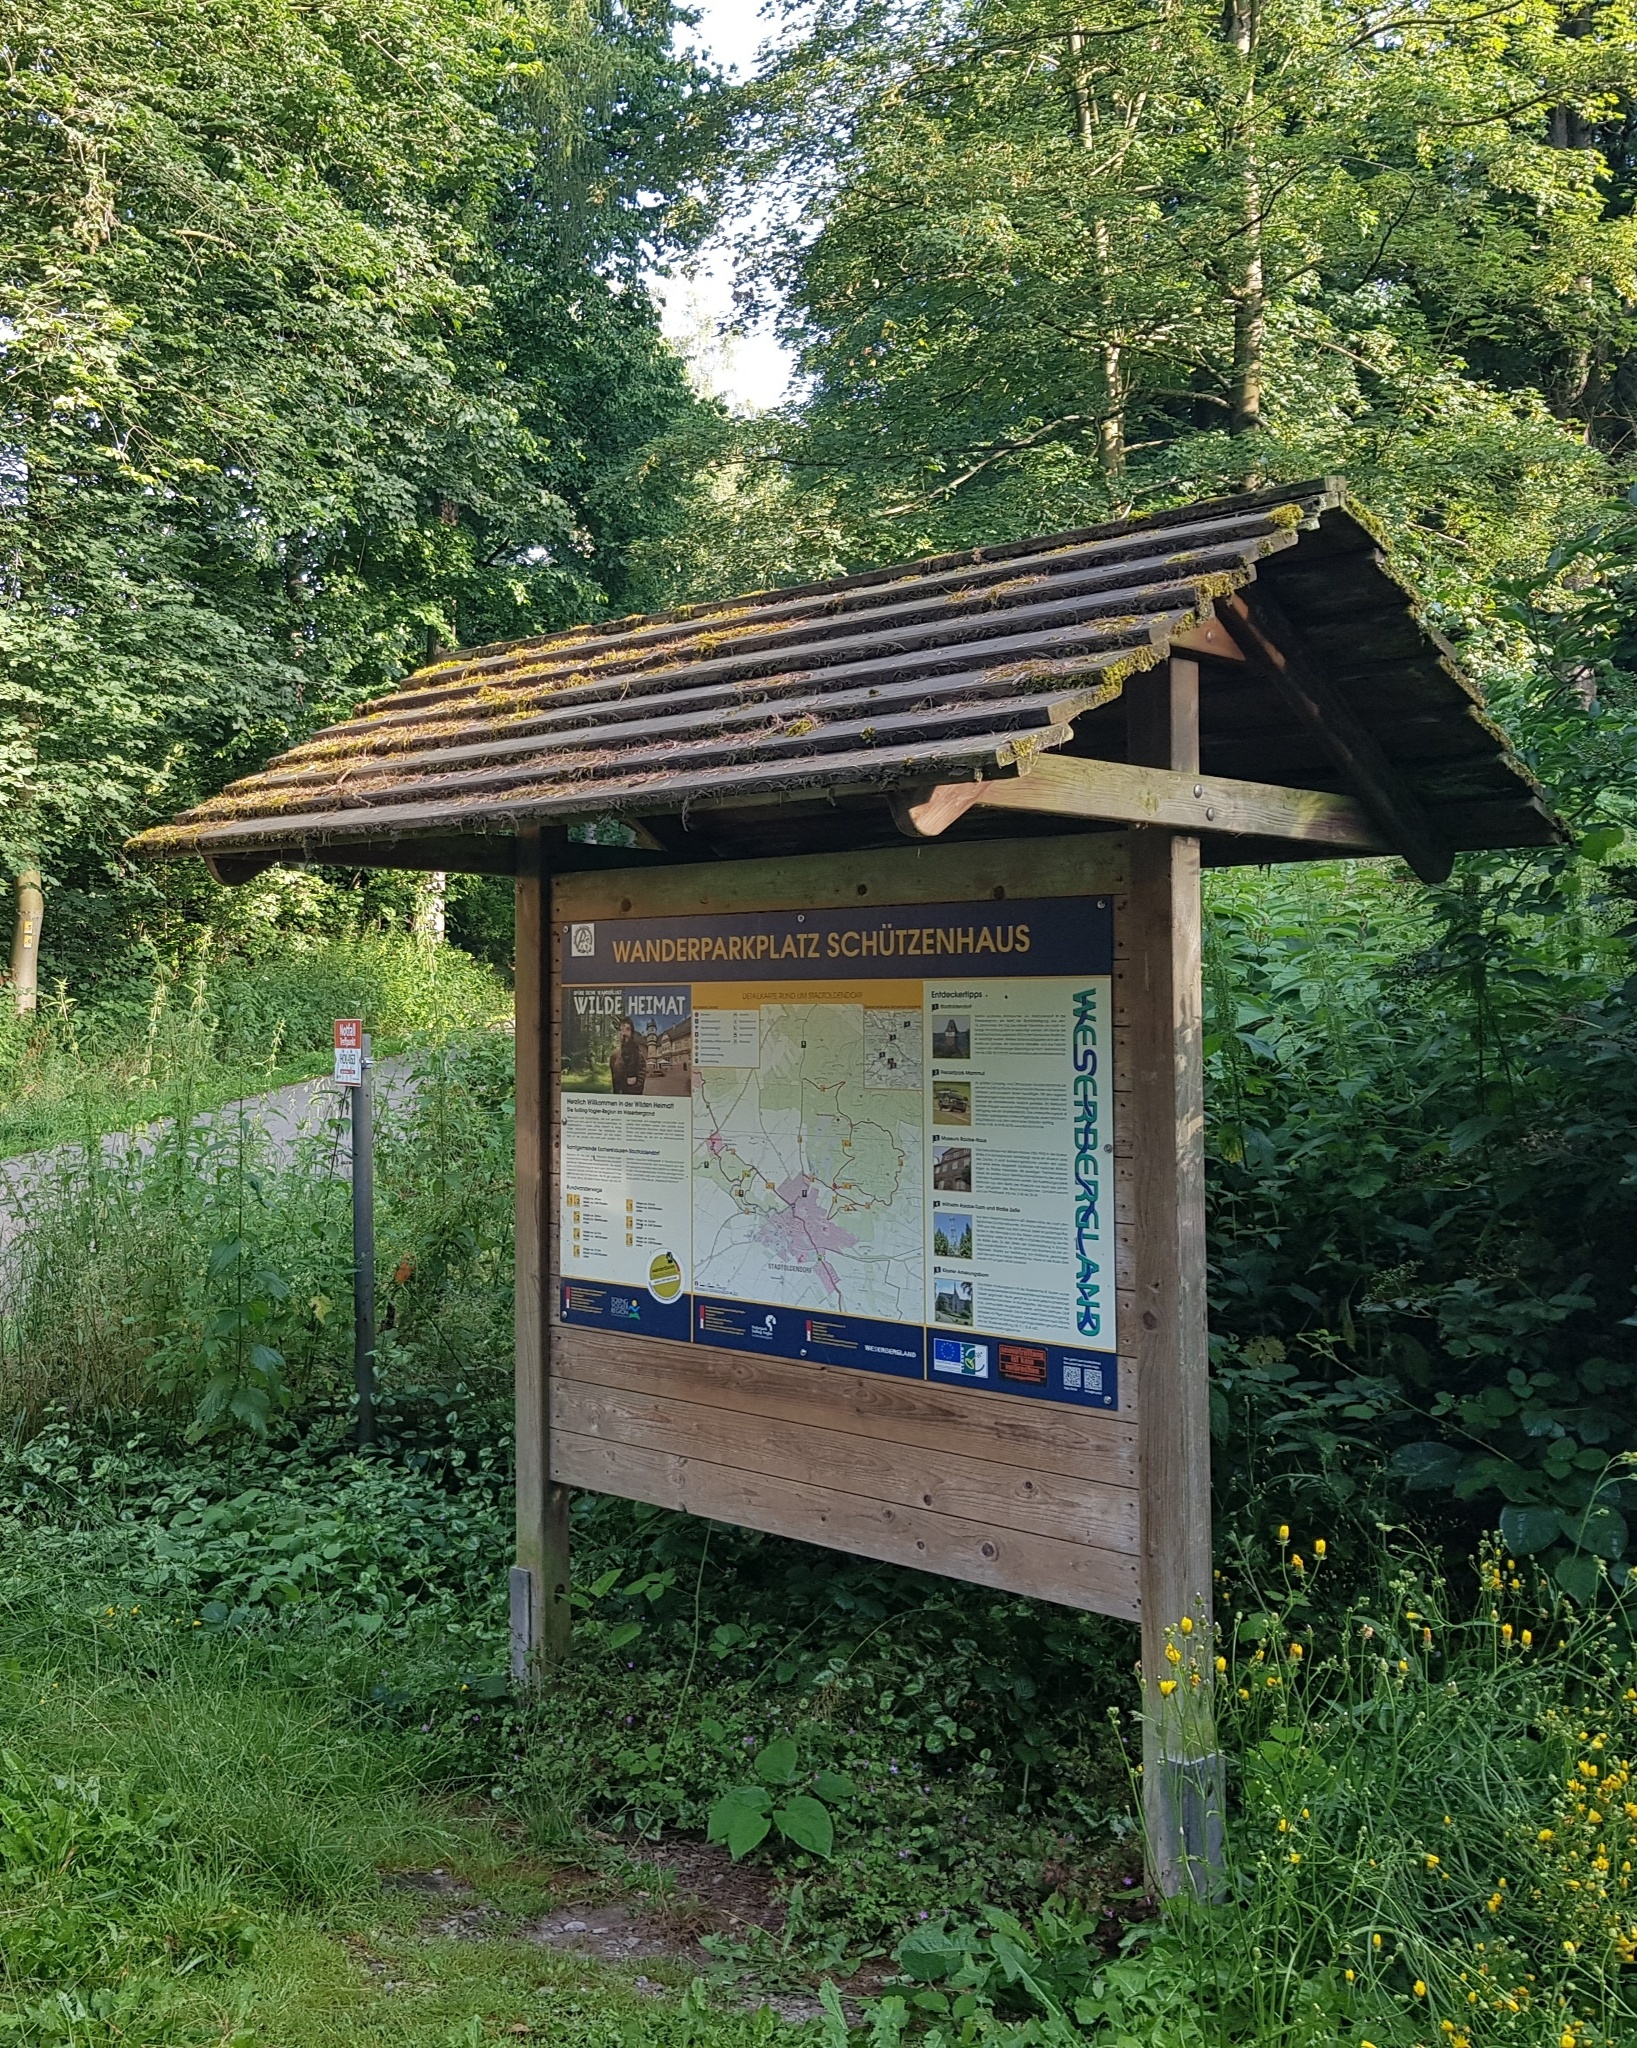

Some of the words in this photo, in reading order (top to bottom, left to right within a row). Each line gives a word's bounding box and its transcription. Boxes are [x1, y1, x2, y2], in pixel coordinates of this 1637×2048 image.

[612, 932, 820, 963] WANDERPARKPLATZ
[827, 924, 1031, 958] SCHÜTZENHAUS
[742, 992, 778, 1000] DETAILKARTE
[780, 992, 796, 1000] RUND
[808, 991, 863, 999] STADTOLDENDORF
[931, 991, 983, 999] Entdeckertipps
[573, 996, 622, 1015] WILDE
[628, 995, 686, 1015] HEIMAT
[339, 1023, 356, 1037] Notfall
[339, 1037, 356, 1047] Treffpunkt
[588, 1099, 618, 1107] Willkommen
[1072, 988, 1101, 1337] WESERBERGLAND
[768, 1263, 813, 1274] STADTOLDENDORF
[864, 1344, 917, 1358] WESERBERGLAND
